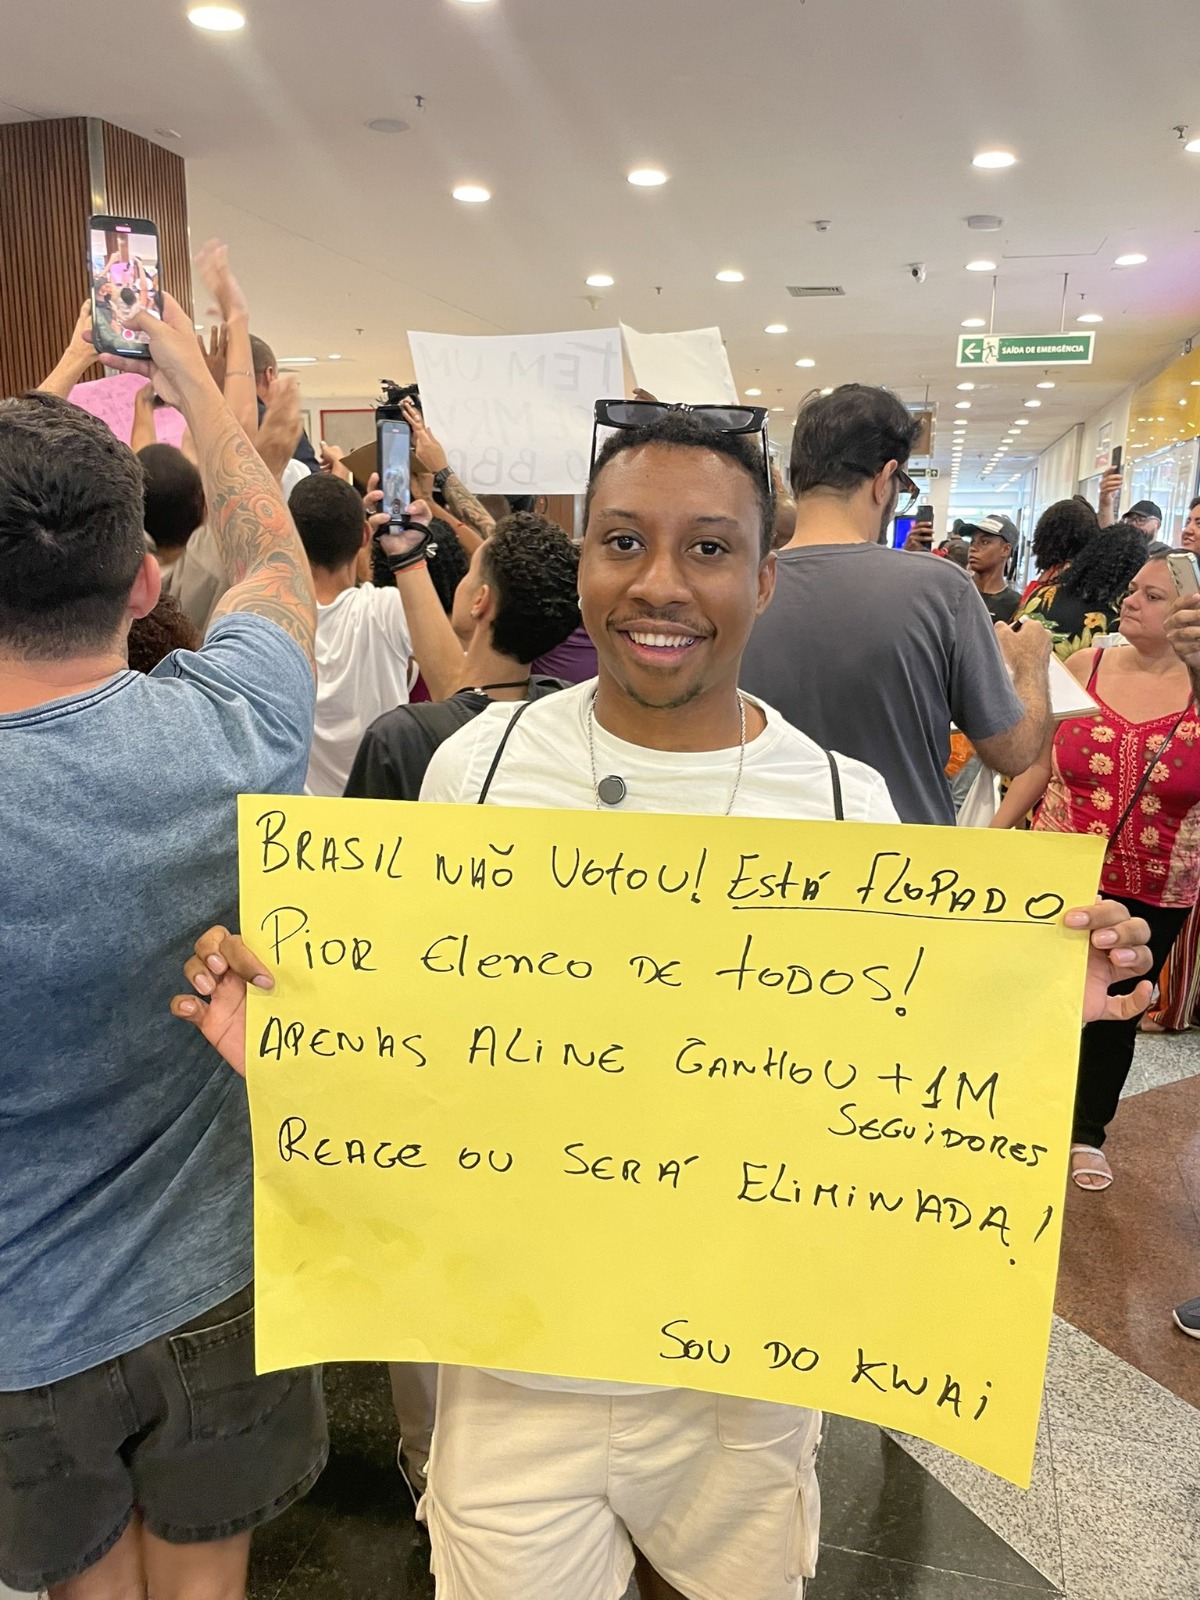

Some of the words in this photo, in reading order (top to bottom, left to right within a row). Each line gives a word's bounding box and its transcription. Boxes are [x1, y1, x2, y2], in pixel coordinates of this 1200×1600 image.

[1001, 345, 1024, 355] SAÍDA
[1025, 345, 1035, 354] DE
[1036, 344, 1085, 354] EMERGÊNCIA
[255, 809, 403, 879] BRASIL
[628, 955, 682, 987] DE
[259, 1015, 427, 1068] APENAS
[675, 1037, 857, 1090] GANHOU
[458, 1146, 514, 1173] OU
[563, 1142, 700, 1189] SERÁ
[763, 1341, 820, 1372] DO
